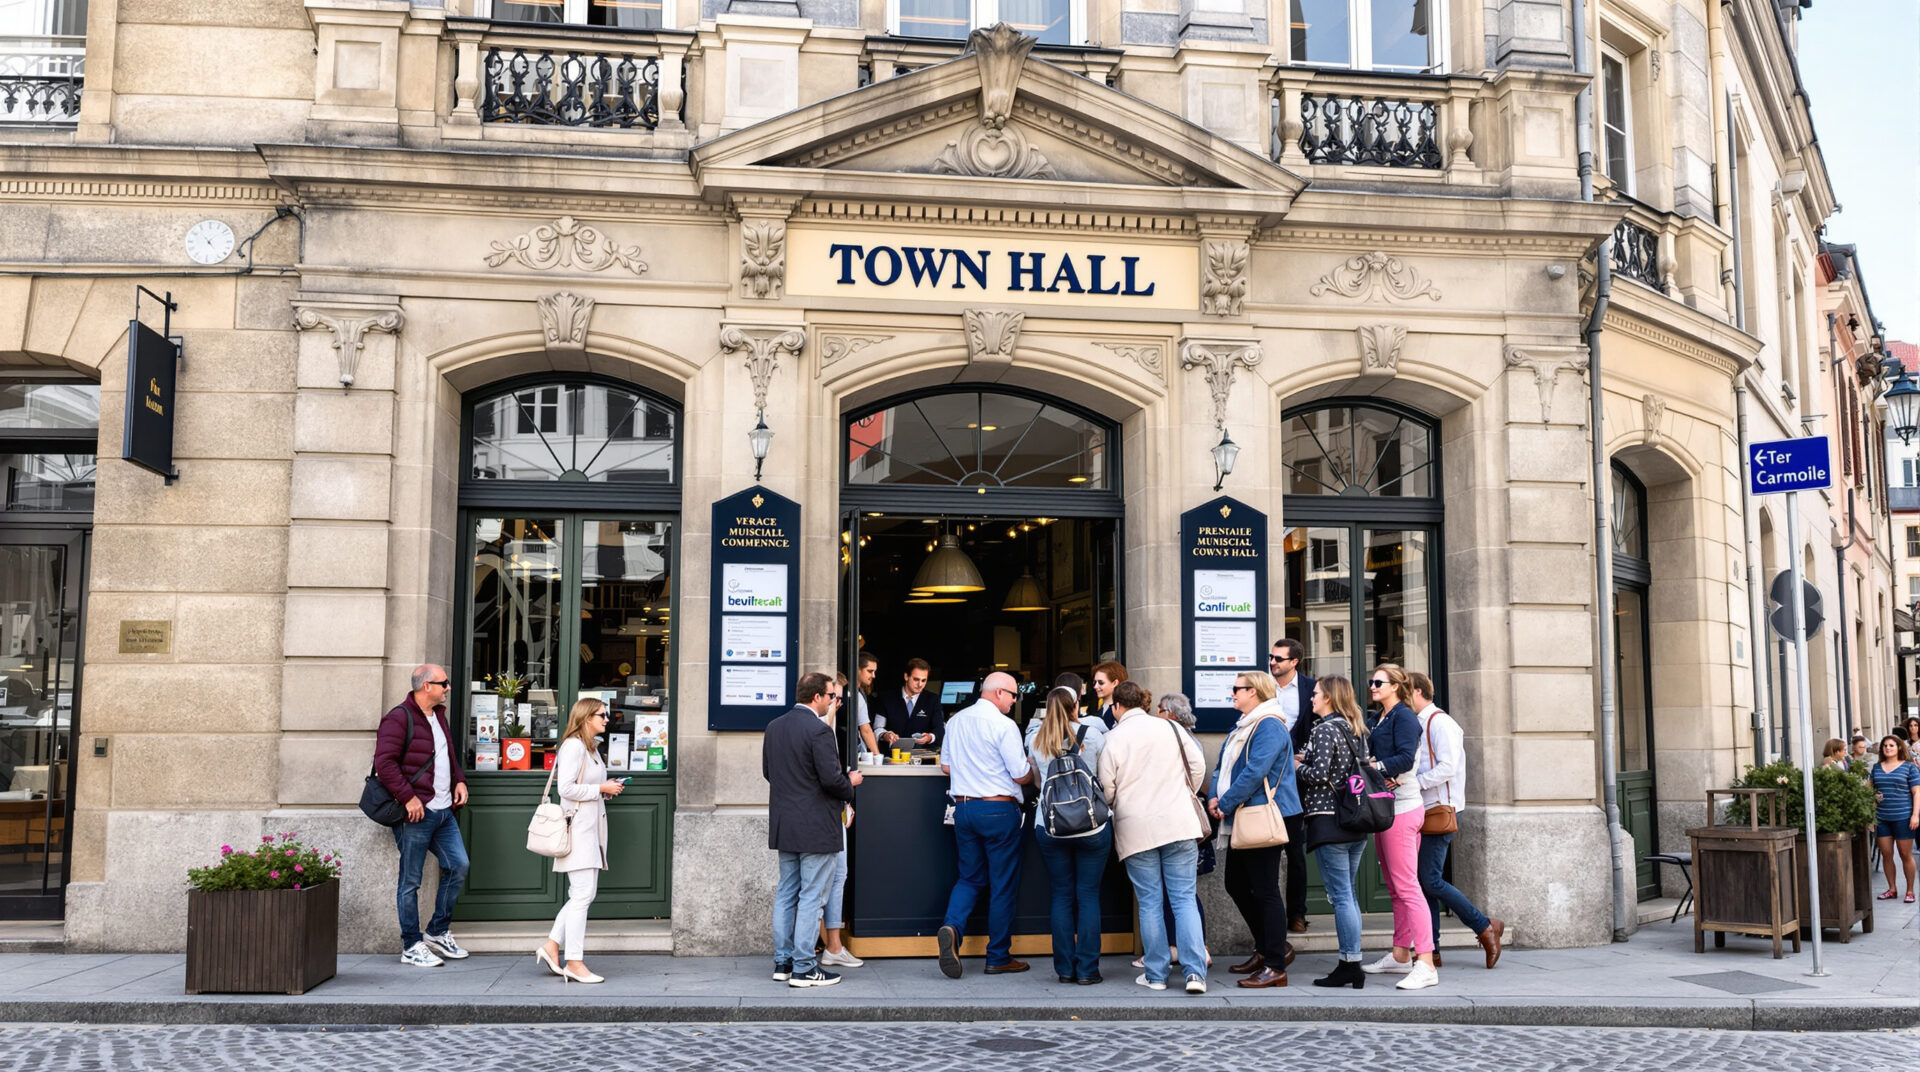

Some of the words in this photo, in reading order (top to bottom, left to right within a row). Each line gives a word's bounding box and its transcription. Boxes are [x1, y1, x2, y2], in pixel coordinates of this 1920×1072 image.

[829, 243, 991, 290] TOWN
[1007, 250, 1155, 297] HALL
[1767, 450, 1792, 464] Ter
[1756, 465, 1826, 485] Carmoile
[736, 517, 777, 526] VERACE
[1232, 548, 1259, 557] HALL
